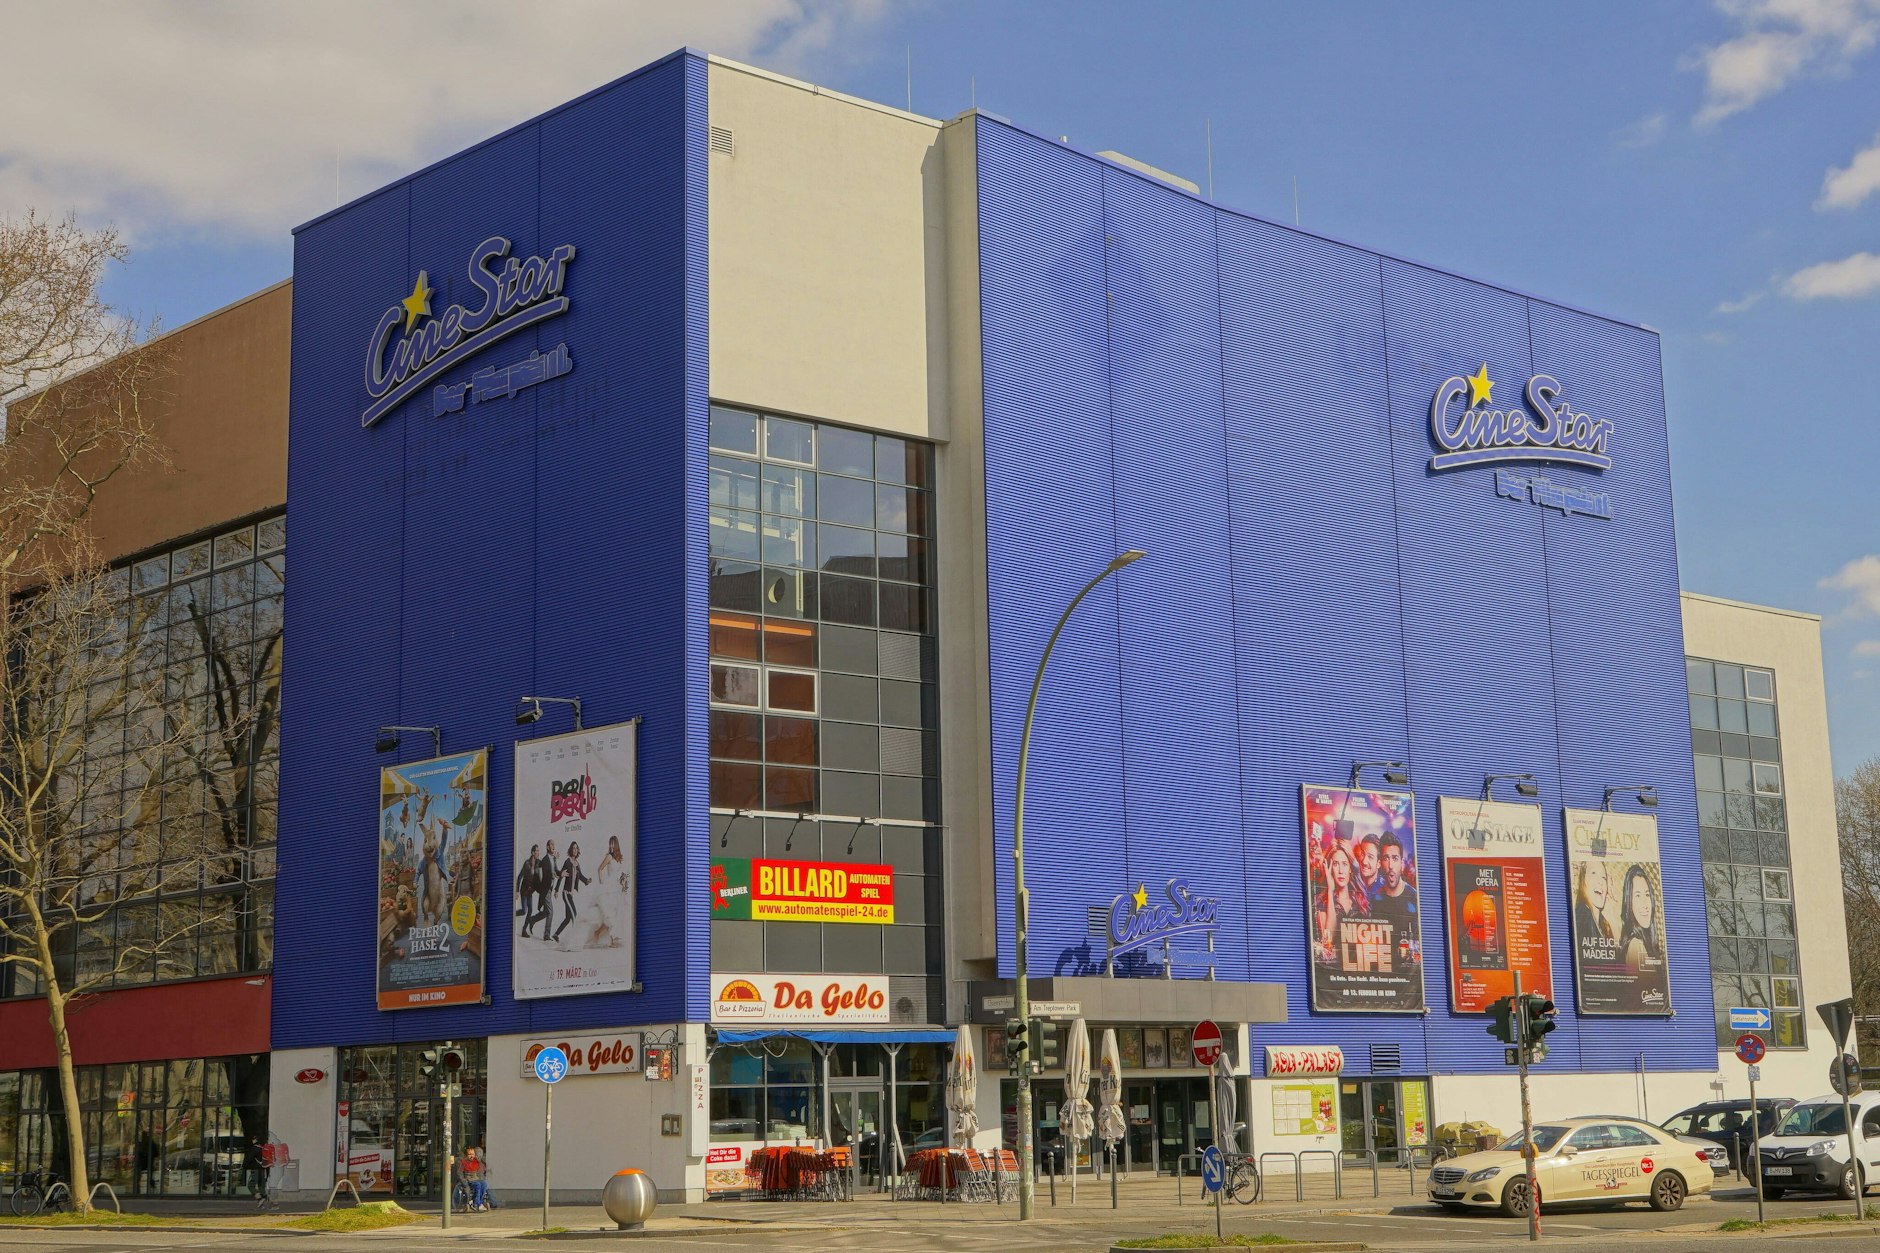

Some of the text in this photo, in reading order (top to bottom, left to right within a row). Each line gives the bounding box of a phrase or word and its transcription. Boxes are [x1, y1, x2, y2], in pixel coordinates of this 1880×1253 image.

[365, 237, 575, 397] CineStar
[1431, 373, 1613, 452] CineStar
[1482, 821, 1535, 844] STAGE
[849, 873, 890, 885] AUTOMATEN
[1479, 869, 1494, 877] MET
[759, 866, 847, 899] BILLARD
[1475, 877, 1499, 887] OPERA
[719, 885, 748, 897] BERLINER
[861, 887, 880, 899] SPIEL
[758, 904, 888, 918] www.automatenspiel-24.de
[1107, 878, 1221, 943] CineStar
[408, 925, 440, 940] PETER
[411, 922, 450, 953] HASE 2
[1340, 923, 1394, 944] NIGHT
[1582, 937, 1598, 947] AUF
[1342, 943, 1393, 972] LIFE
[1583, 948, 1616, 960] MÄDELS!
[566, 967, 582, 979] MÄRZ
[409, 993, 420, 1002] NUR
[430, 992, 446, 1000] KINO
[774, 982, 884, 1016] Da Gelo
[719, 1004, 731, 1012] Bar
[738, 1004, 763, 1013] Pizzeria
[588, 1040, 634, 1071] Gelo
[1581, 1167, 1641, 1181] TAGESSPIEGEL
